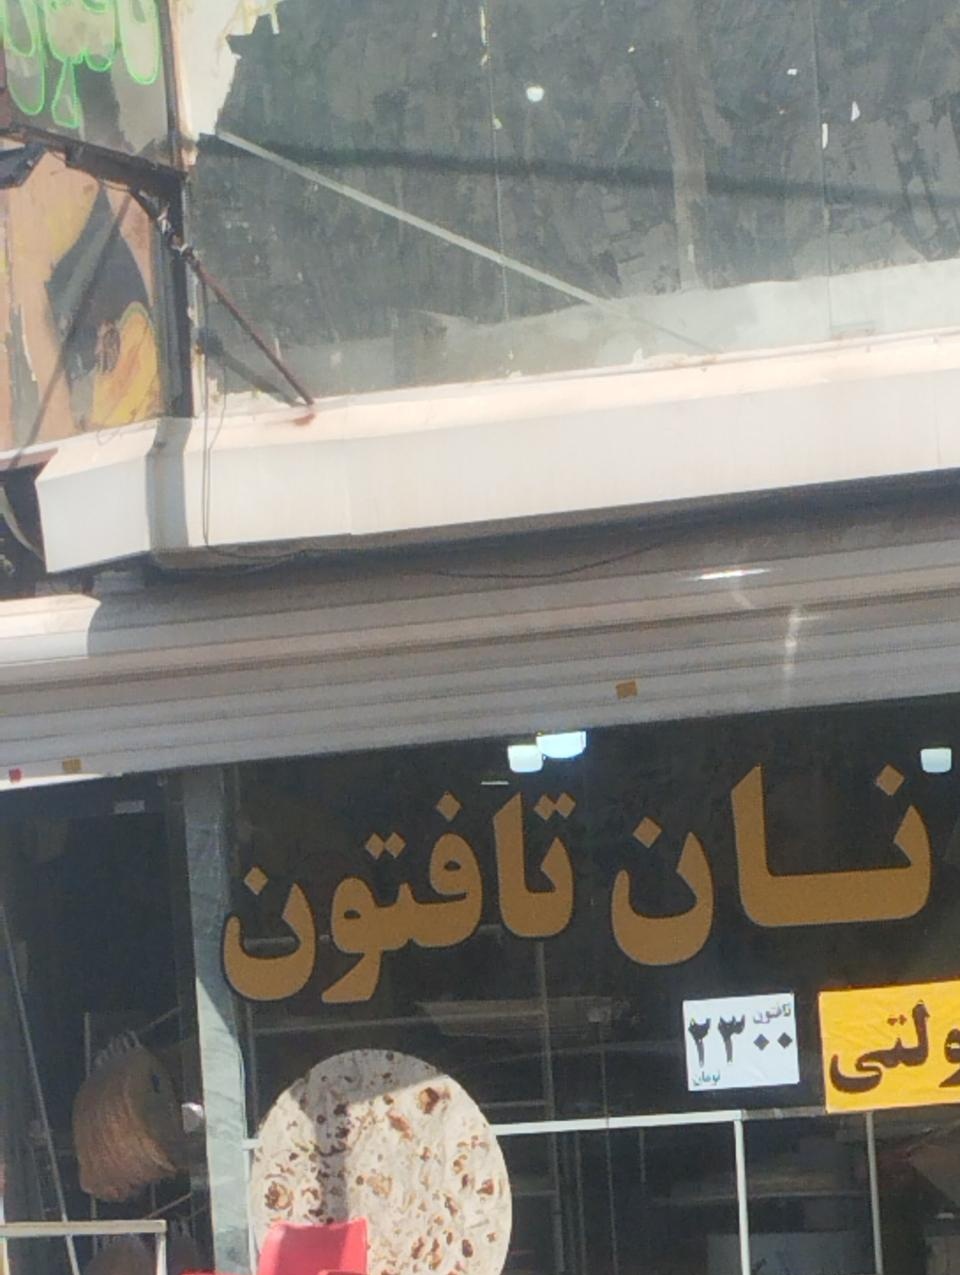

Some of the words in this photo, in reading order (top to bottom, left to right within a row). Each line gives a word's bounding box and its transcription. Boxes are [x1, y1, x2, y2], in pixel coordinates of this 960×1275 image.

[222, 791, 576, 1003] تافتون
[611, 764, 932, 966] نان
[688, 1014, 793, 1068] ۲۳۰۰
